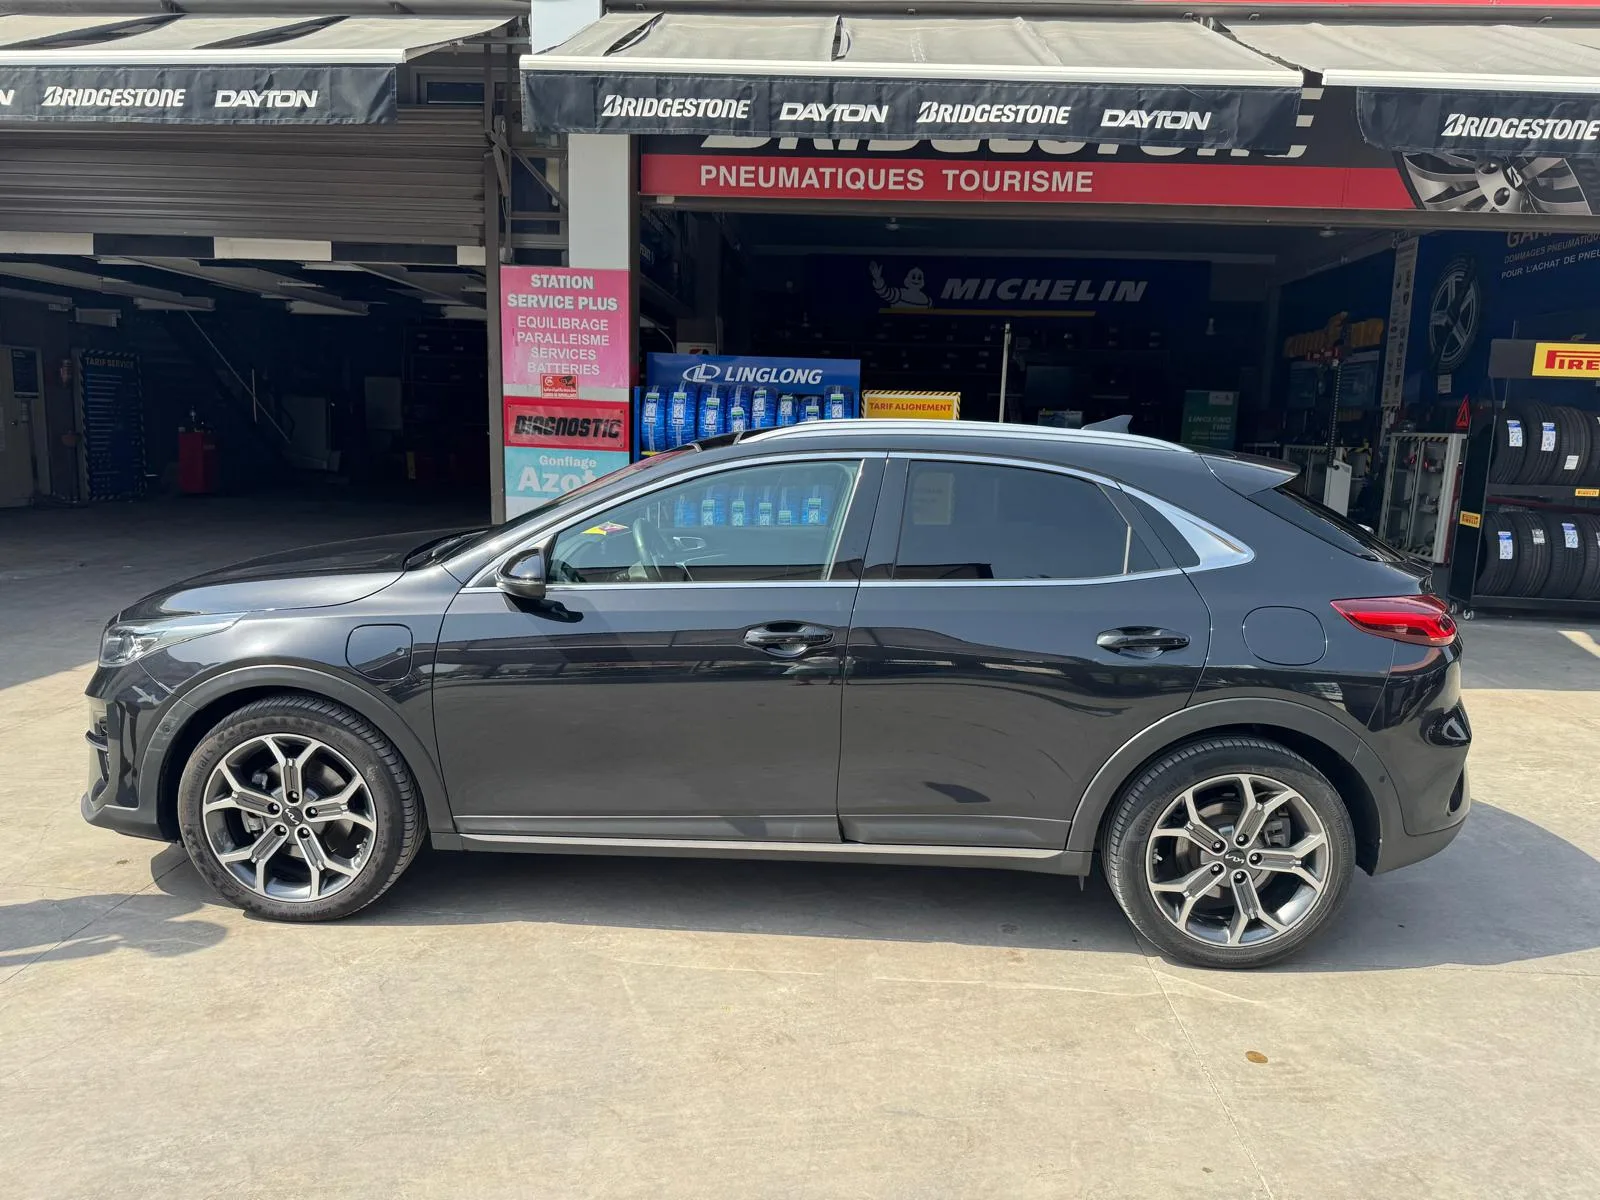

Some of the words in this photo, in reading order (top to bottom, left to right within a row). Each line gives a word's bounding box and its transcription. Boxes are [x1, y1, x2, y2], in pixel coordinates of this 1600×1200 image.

[41, 86, 186, 107] BRIDGESTONE
[214, 89, 319, 108] DAYTON
[601, 94, 751, 120] BRIDGESTONE
[779, 102, 889, 123] DAYTON
[916, 101, 1072, 125] BRIDGESTONE
[1100, 108, 1212, 131] DAYTON
[1441, 113, 1600, 140] BRIDGESTONE
[700, 164, 925, 191] PNEUMATIQUES
[941, 168, 1094, 193] TOURISME
[1501, 267, 1524, 280] POUR
[1526, 258, 1561, 274] L'ACHAT
[1563, 254, 1577, 265] DE
[530, 273, 595, 290] STATION
[938, 277, 1149, 302] MICHELIN
[507, 293, 574, 309] SERVICE
[578, 295, 619, 311] PLUS
[517, 315, 609, 331] EQUILIBRAGE
[530, 346, 597, 361] SERVICES
[527, 361, 600, 375] BATTERIES
[724, 365, 824, 385] LINGLONG
[869, 402, 893, 411] TARIF
[895, 402, 953, 412] ALIGNEMENT
[514, 414, 623, 439] DIAGNOSTIC
[539, 455, 597, 470] Gonflage
